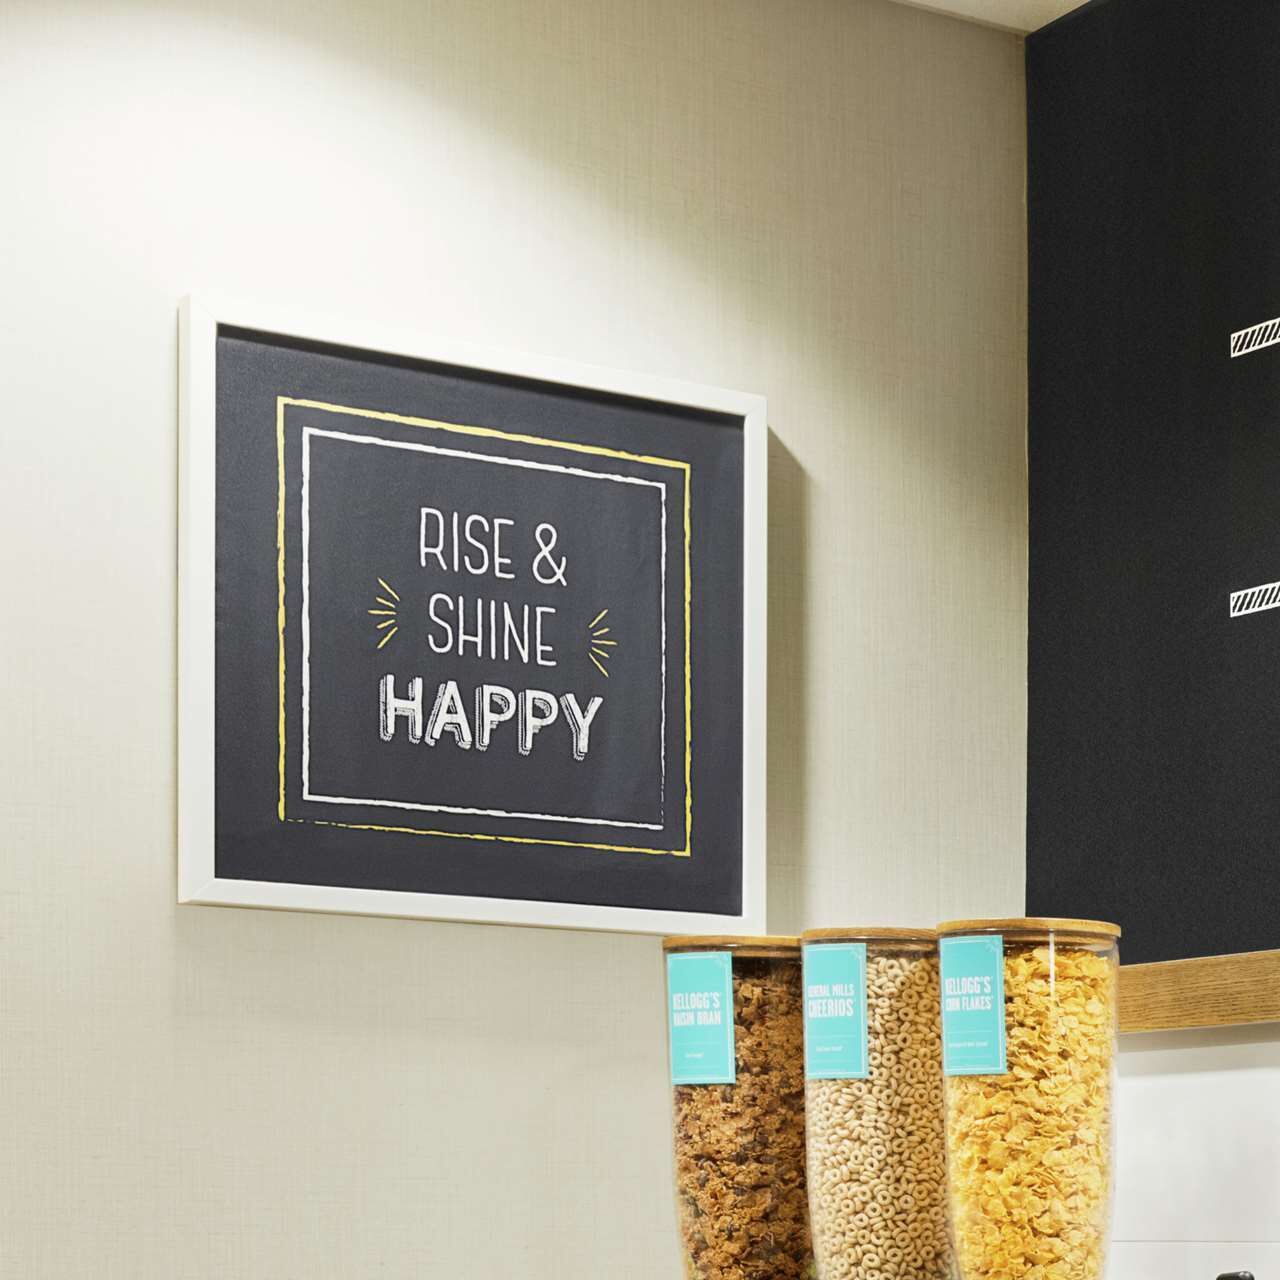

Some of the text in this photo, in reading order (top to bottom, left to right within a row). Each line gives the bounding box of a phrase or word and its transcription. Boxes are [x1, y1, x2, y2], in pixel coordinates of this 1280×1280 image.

[420, 507, 567, 586] RISE &
[427, 593, 557, 667] SHINE
[378, 674, 604, 761] HAPPY
[832, 984, 854, 996] MILLS
[808, 1000, 854, 1018] CHEERIOS
[962, 996, 991, 1011] FLAKES
[696, 1011, 721, 1025] BRAN
